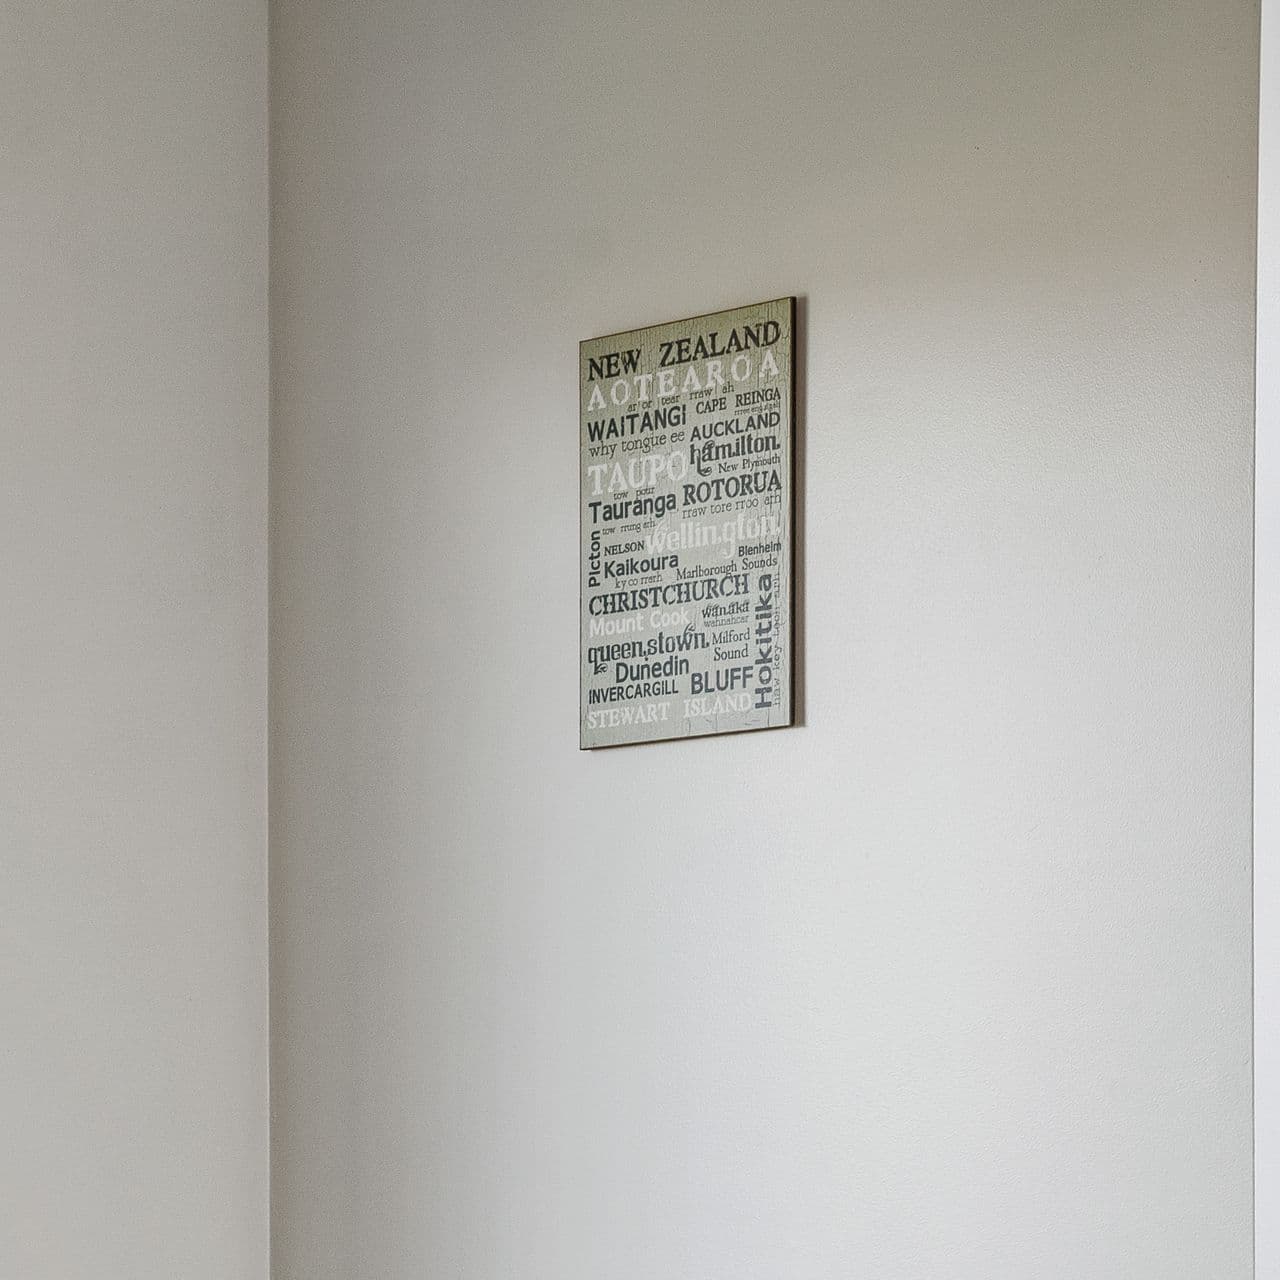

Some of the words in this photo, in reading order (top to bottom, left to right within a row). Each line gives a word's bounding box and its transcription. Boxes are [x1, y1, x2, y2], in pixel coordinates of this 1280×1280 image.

[587, 348, 641, 382] NEW
[659, 320, 781, 367] ZEALAND
[587, 350, 779, 411] AOTEAROA
[696, 396, 727, 414] CAPE
[735, 387, 781, 407] REINGA
[690, 412, 780, 442] AUCKLAND
[589, 441, 617, 459] why
[621, 433, 667, 453] tongue
[670, 431, 685, 443] ee
[587, 451, 687, 496] TAUPO
[718, 461, 739, 473] New
[742, 453, 780, 472] Plymouth
[683, 469, 782, 506] ROTORUA
[589, 493, 676, 524] Tauranga
[682, 507, 707, 519] rraw
[710, 502, 732, 514] tore
[735, 498, 759, 510] rroo
[588, 530, 600, 588] Picton
[604, 540, 645, 556] NELSON
[738, 541, 781, 557] Blenheim
[604, 554, 679, 579] Kaikoura
[676, 560, 737, 580] Marlborough
[742, 553, 778, 571] Sounds
[589, 573, 751, 616] CHRISTCHURCH
[589, 612, 645, 638] Mount
[650, 607, 690, 629] Cook
[712, 627, 750, 645] Milford
[714, 643, 749, 661] Sound
[755, 574, 773, 709] Hokitika
[616, 655, 689, 683] Dunedin
[691, 665, 754, 695] BLUFF
[589, 680, 679, 705] INVERCARGILL
[587, 702, 670, 729] STEWART
[683, 692, 752, 719] ISLAND
